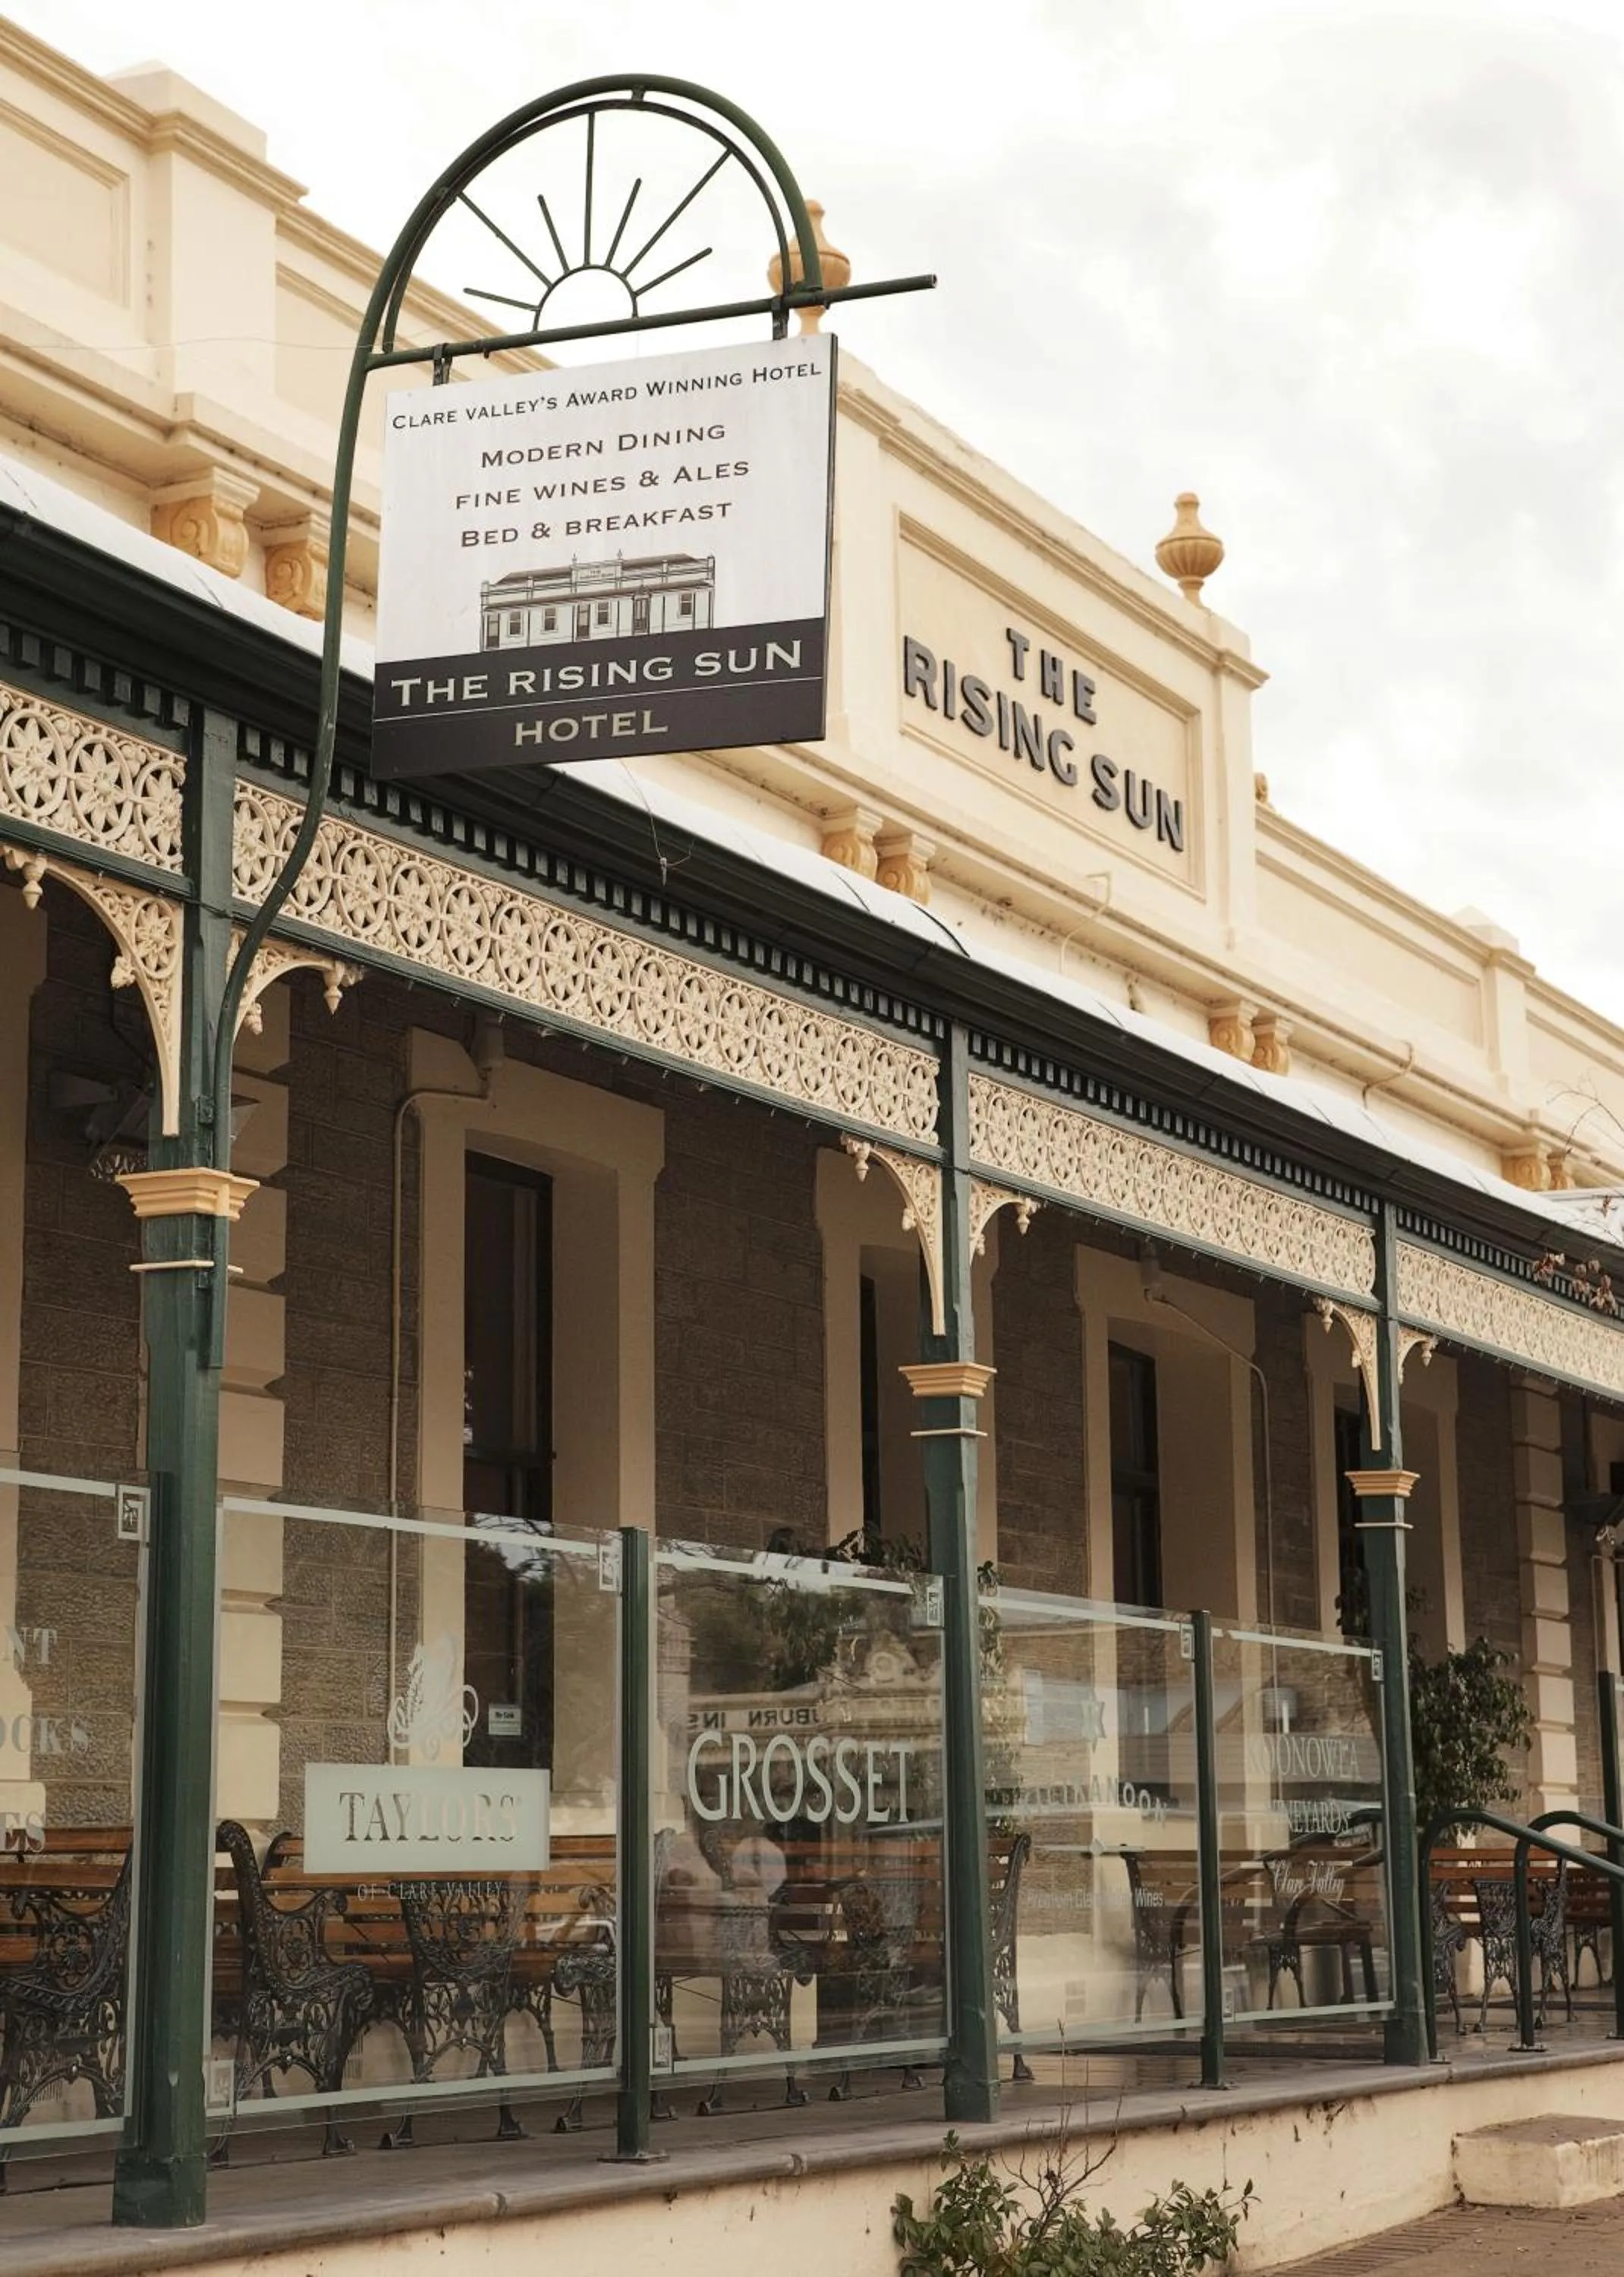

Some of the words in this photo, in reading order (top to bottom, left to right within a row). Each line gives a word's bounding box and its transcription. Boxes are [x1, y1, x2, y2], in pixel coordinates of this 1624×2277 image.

[392, 409, 457, 430] CLARE
[466, 395, 558, 421] VALLEY'S
[565, 385, 637, 408] AWARD
[646, 372, 743, 397] WINNING
[752, 363, 822, 383] HOTEL
[481, 439, 603, 468] MODERN
[618, 424, 726, 452] DINING
[455, 487, 521, 510] FINE
[533, 475, 626, 501] WINES
[639, 470, 659, 487] &
[673, 461, 751, 483] ALES
[461, 528, 518, 547] BED
[531, 521, 550, 539] &
[565, 502, 732, 536] BREAKFAST
[391, 674, 489, 707] THE
[508, 657, 672, 694] RISING
[694, 640, 803, 677] SUN
[1006, 628, 1097, 725] THE
[514, 710, 669, 746] HOTEL
[903, 635, 1078, 786] RISING
[1091, 754, 1184, 852] SUN
[688, 1731, 914, 1823] GROSSET
[339, 1792, 518, 1842] TAYLORS
[357, 1884, 377, 1902] OF
[446, 1882, 502, 1899] VALLEY
[1135, 1888, 1163, 1907] Wines
